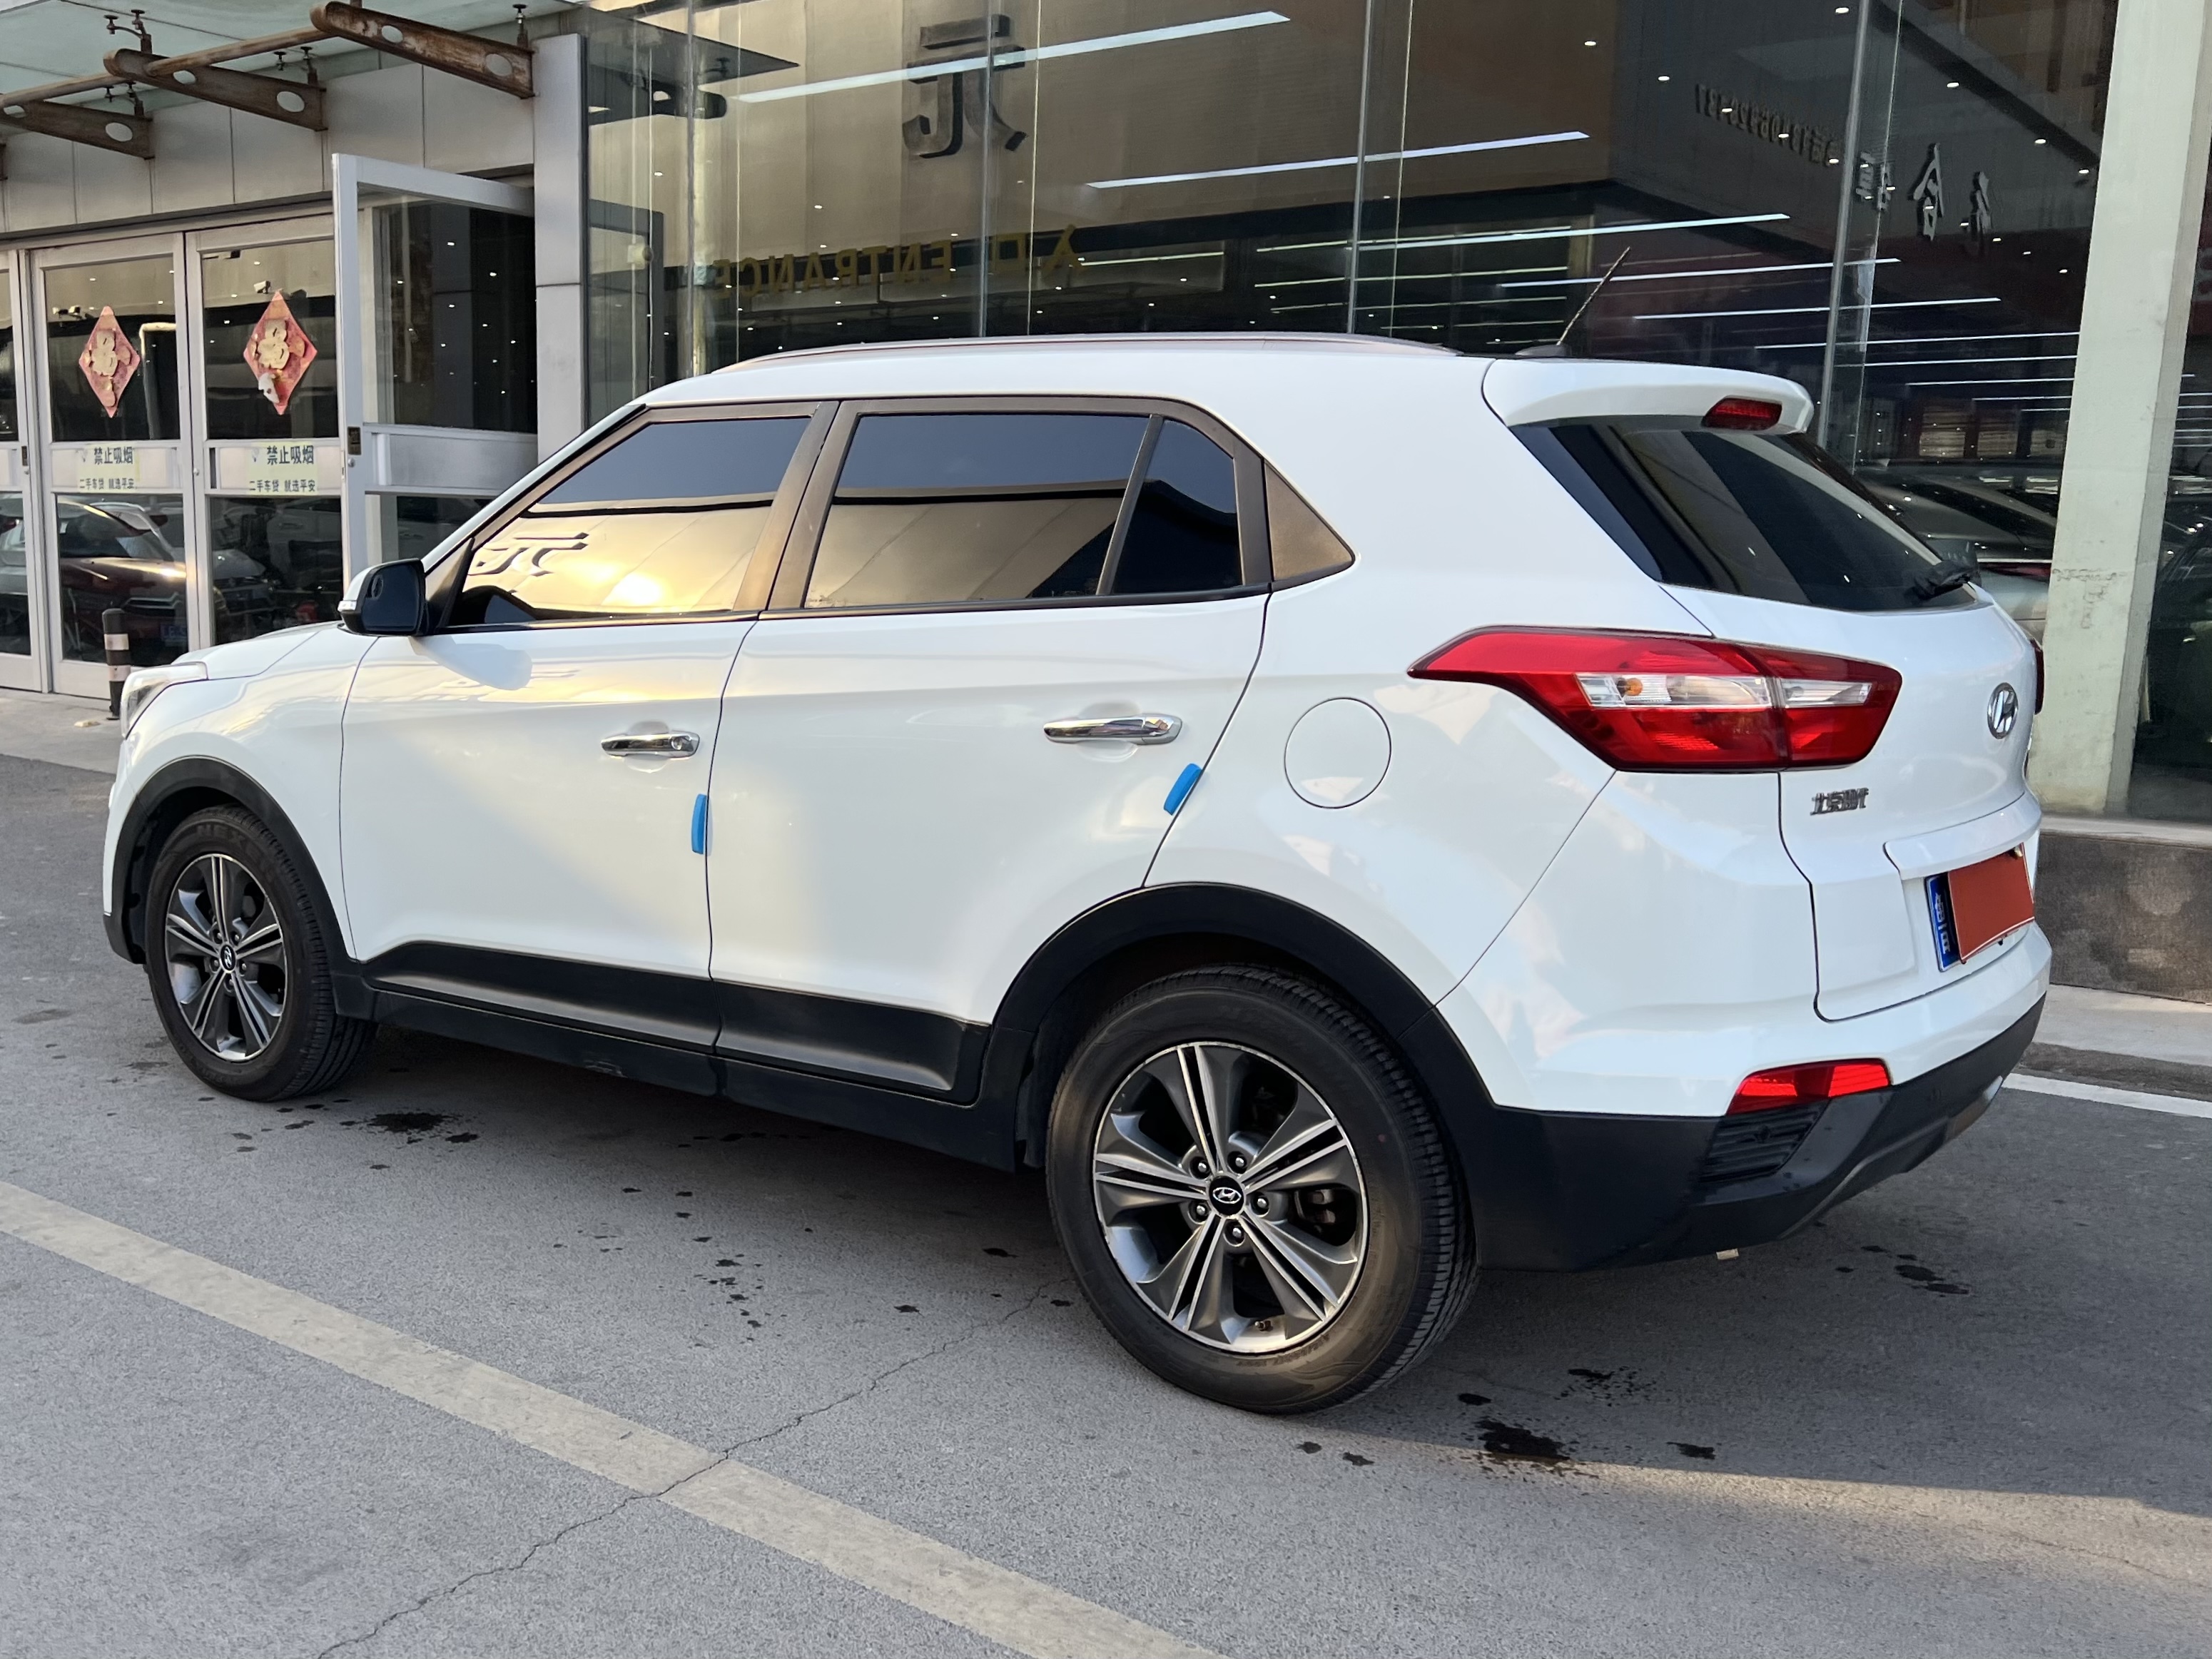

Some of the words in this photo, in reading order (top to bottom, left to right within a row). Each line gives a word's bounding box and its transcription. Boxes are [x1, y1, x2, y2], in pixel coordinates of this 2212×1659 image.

[94, 447, 133, 465] 禁止吸烟
[267, 445, 314, 466] 禁止吸烟
[249, 480, 280, 492] 二手车贷
[284, 479, 316, 492] 就选平安
